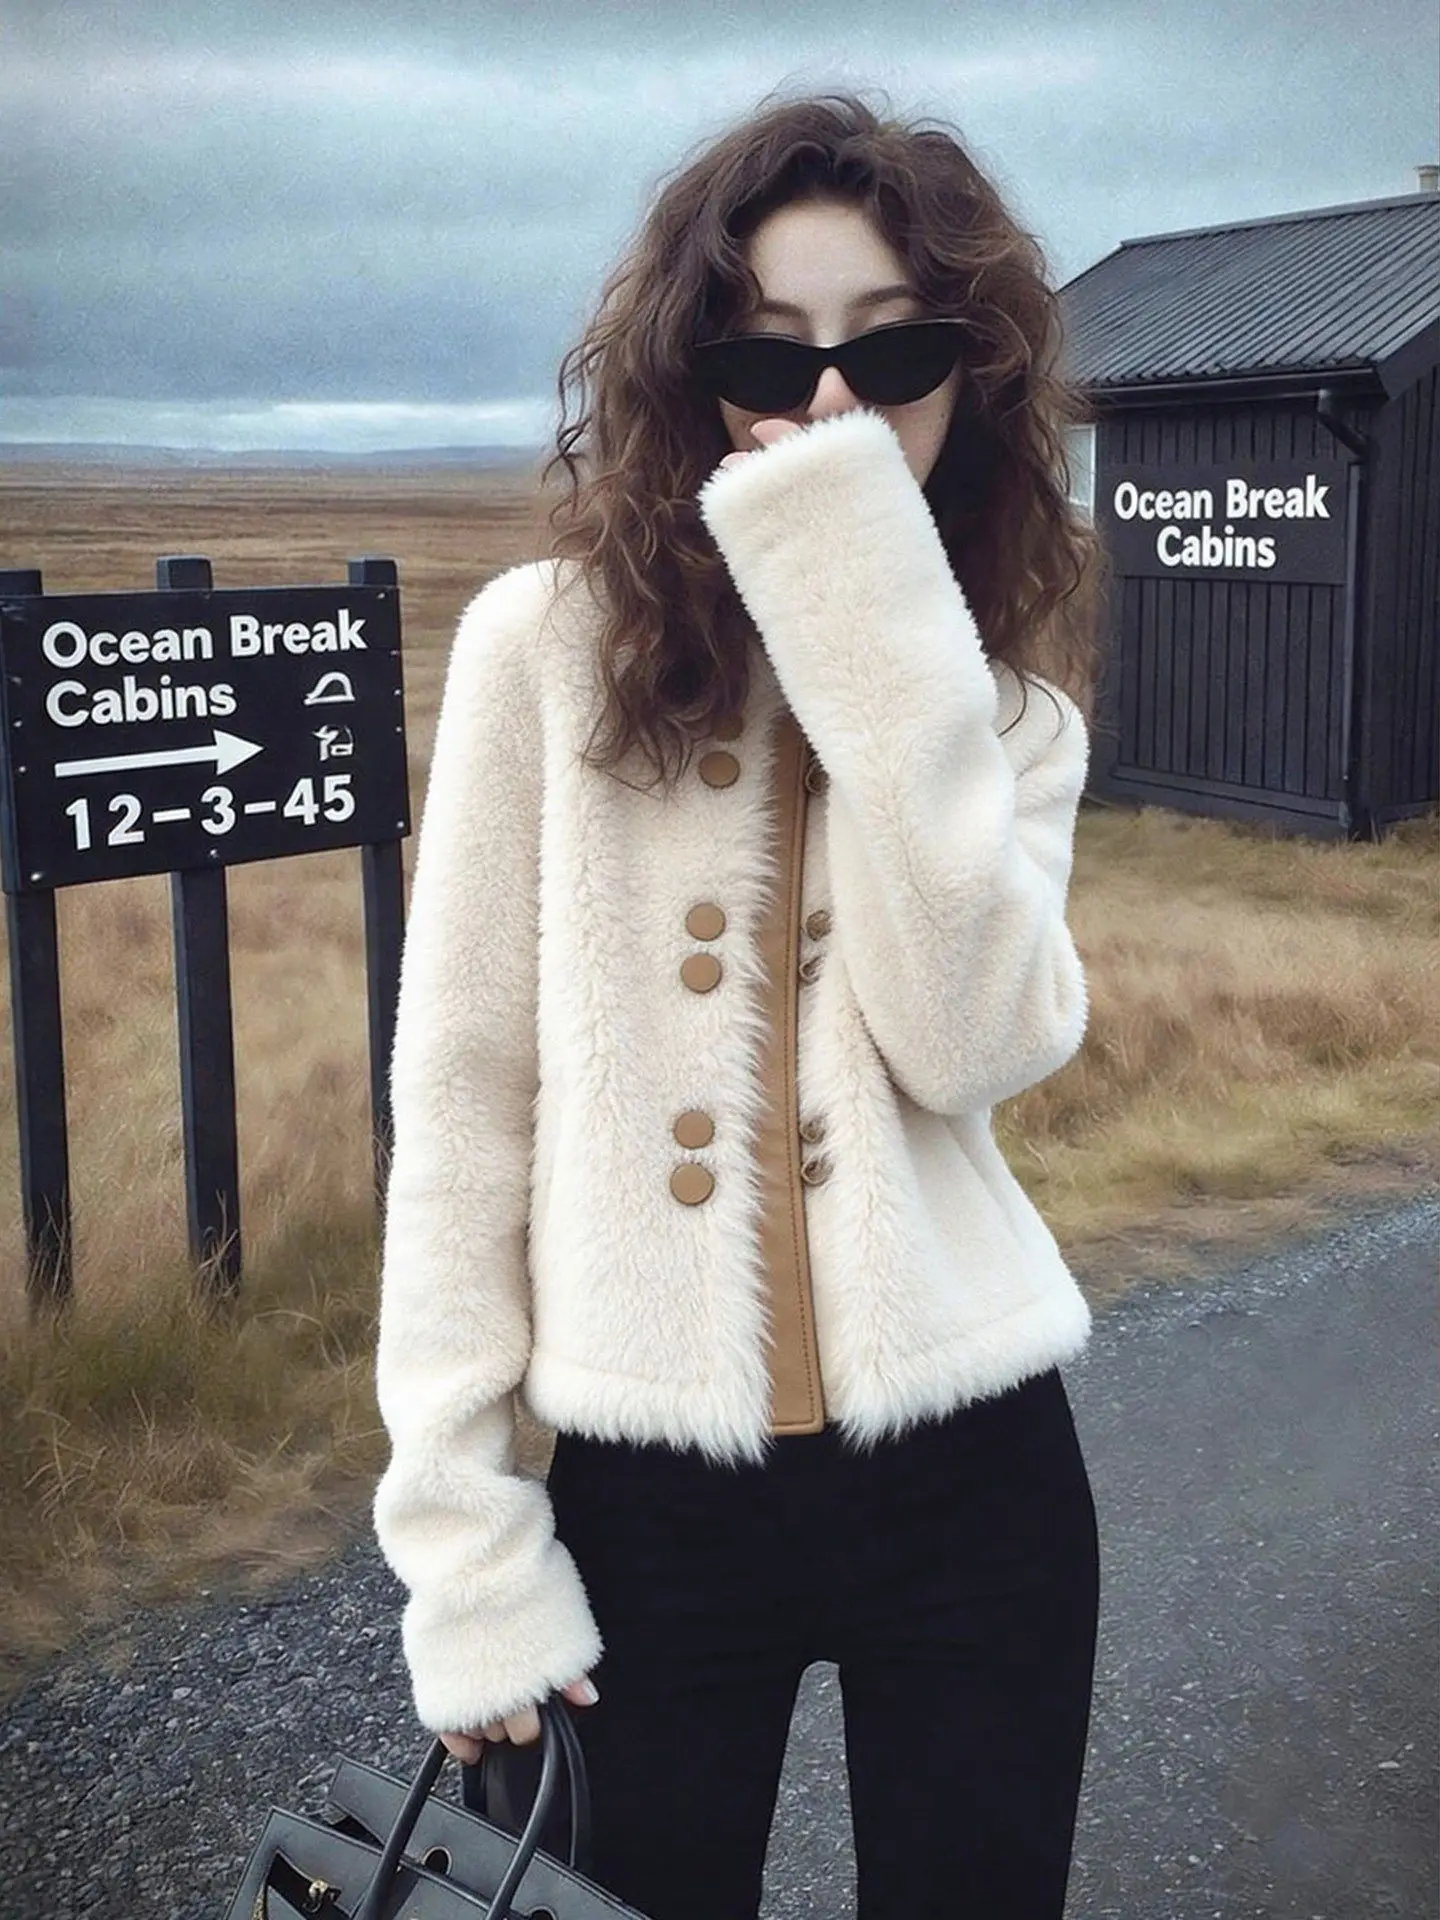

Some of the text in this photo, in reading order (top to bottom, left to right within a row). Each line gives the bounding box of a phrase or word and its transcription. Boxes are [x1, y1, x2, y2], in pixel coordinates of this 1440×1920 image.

[1114, 474, 1330, 520] Ocean Break
[1156, 525, 1276, 568] Cabins
[42, 608, 368, 668] Ocean Break
[45, 674, 238, 728] Cabins
